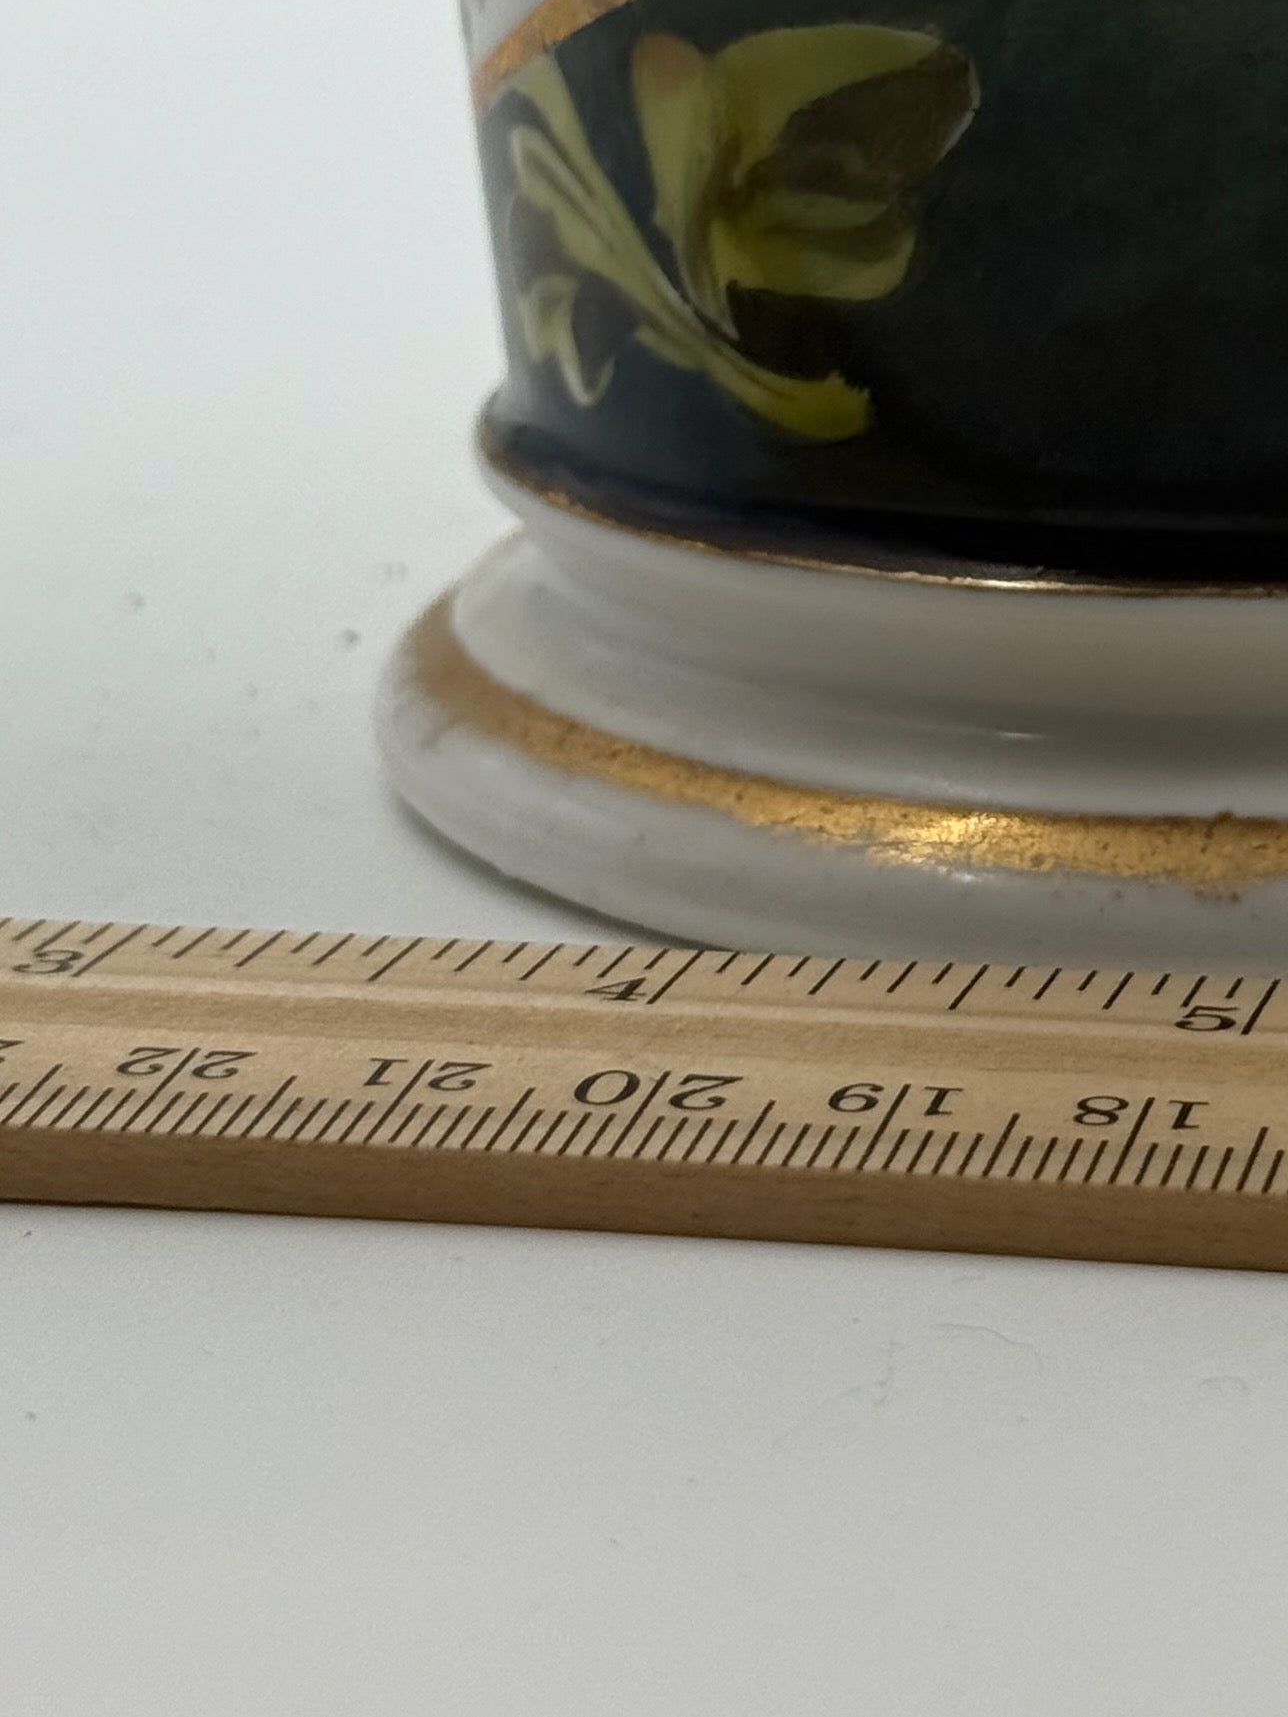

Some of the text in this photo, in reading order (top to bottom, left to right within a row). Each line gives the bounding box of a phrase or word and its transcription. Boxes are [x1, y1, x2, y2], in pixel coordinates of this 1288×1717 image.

[12, 948, 85, 974] 3
[584, 975, 648, 1003] 4
[1174, 1004, 1237, 1032] 5
[116, 1046, 259, 1080] 22
[362, 1057, 493, 1091] 21
[573, 1069, 744, 1111] 20
[827, 1082, 964, 1116] 19
[1072, 1095, 1211, 1130] 18
